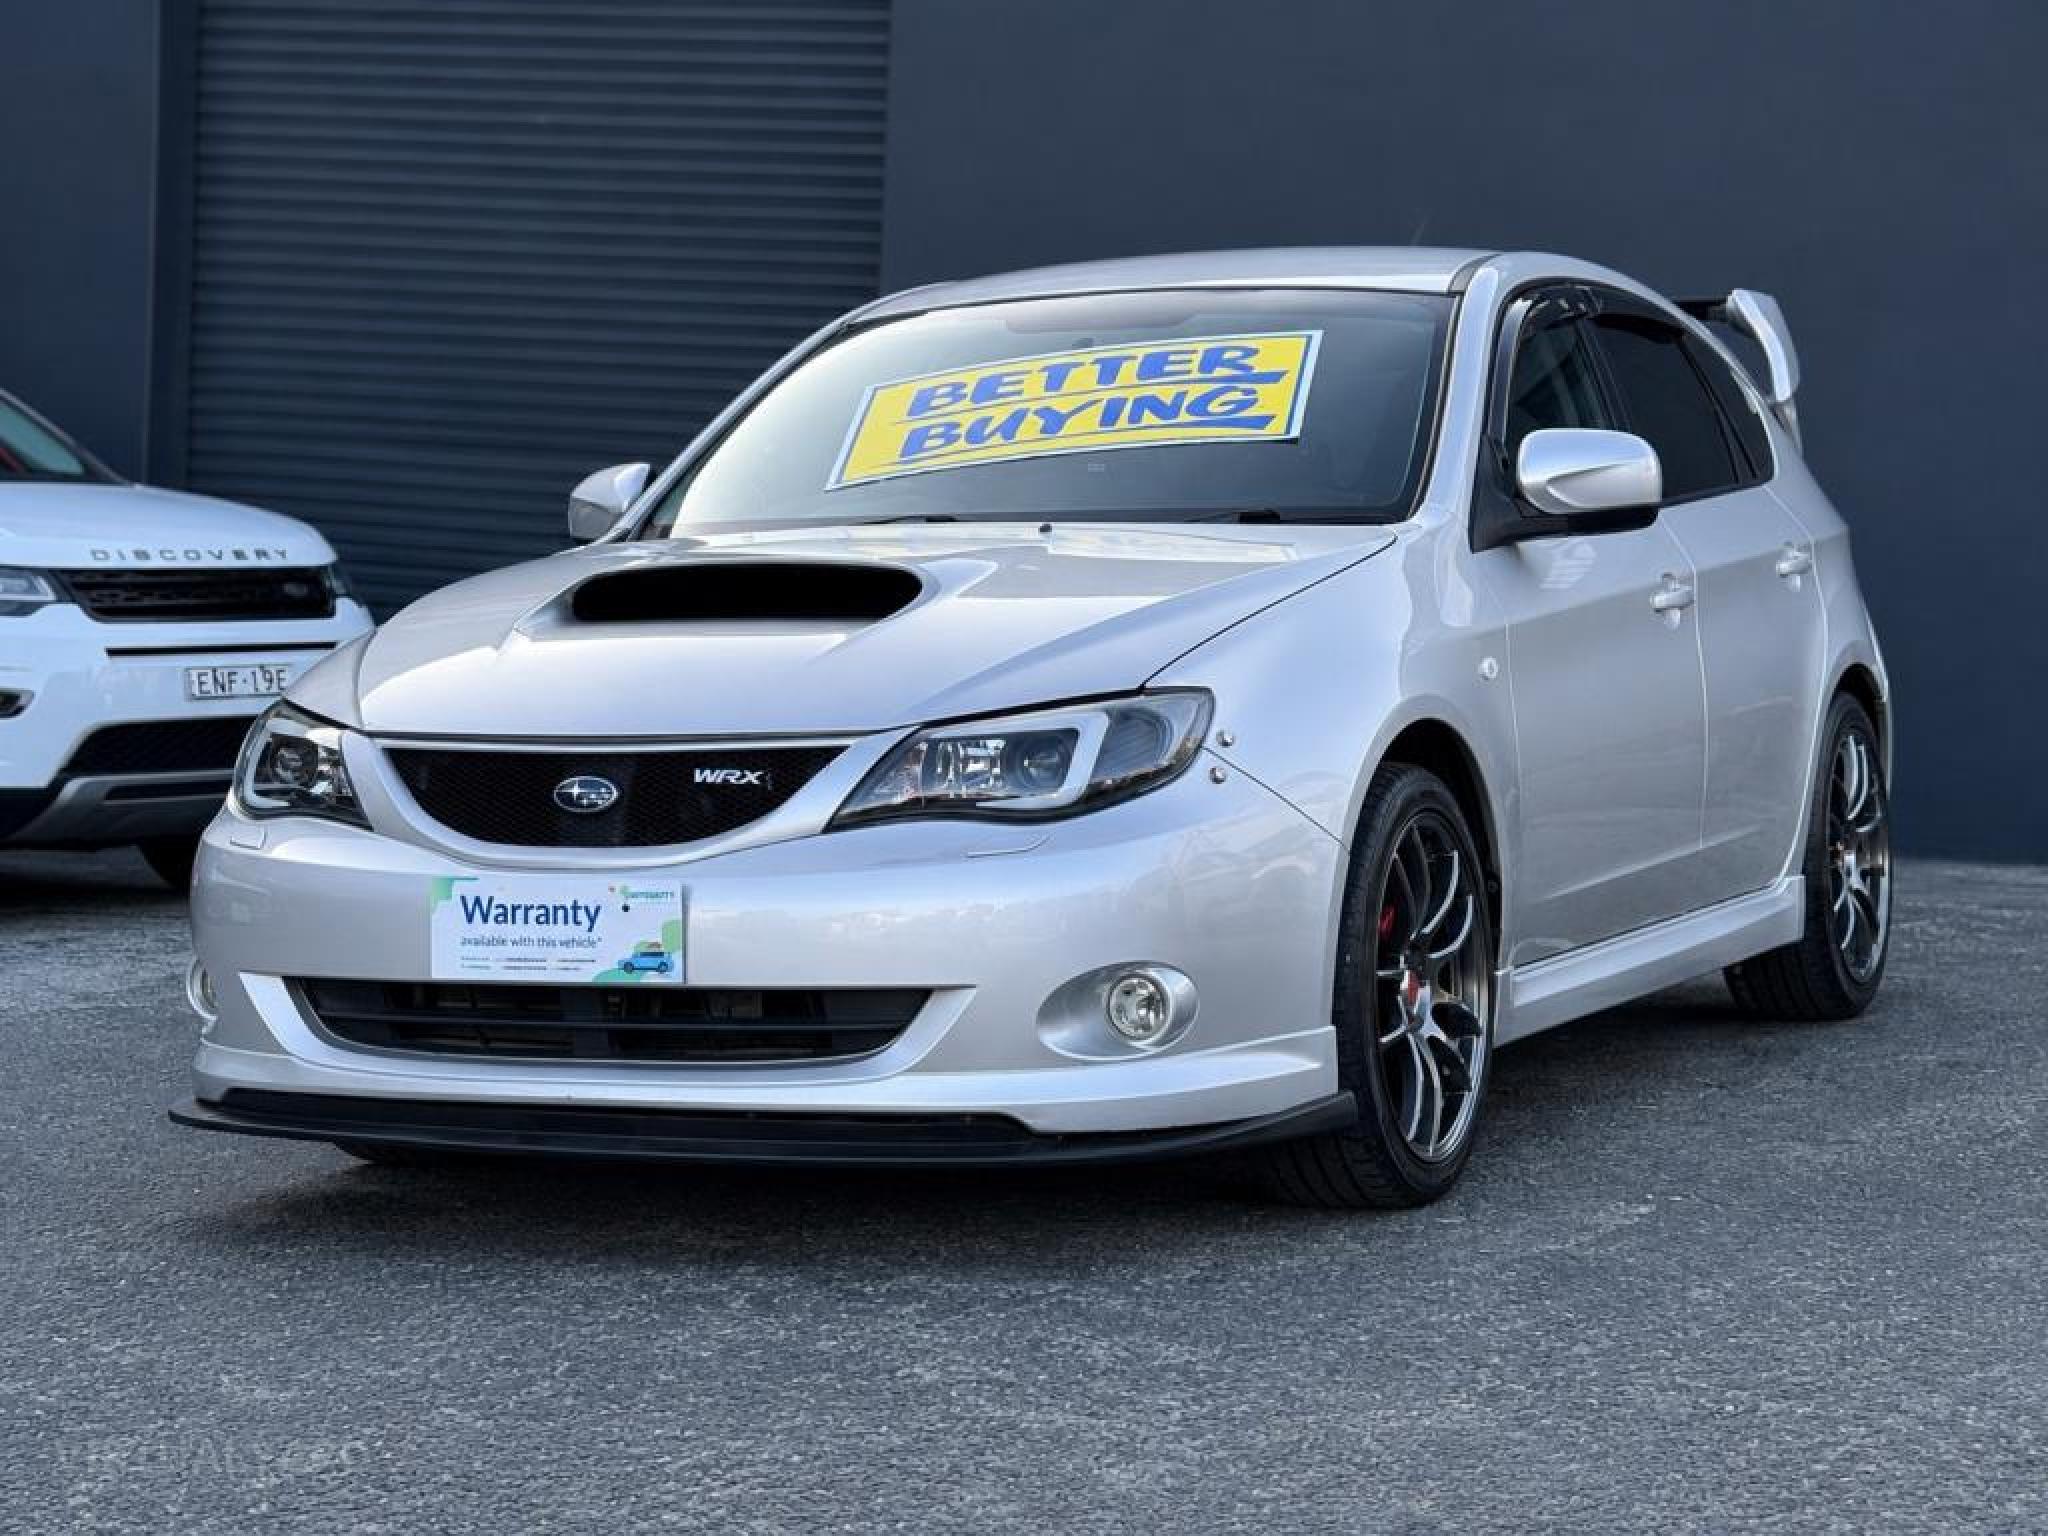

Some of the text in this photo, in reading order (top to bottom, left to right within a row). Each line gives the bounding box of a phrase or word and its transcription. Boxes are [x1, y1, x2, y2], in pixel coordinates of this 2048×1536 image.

[905, 344, 1264, 417] BETTER
[900, 385, 1262, 458] BUYING
[90, 548, 287, 561] DISCOVERY
[694, 768, 763, 784] WRX
[460, 894, 602, 932] Warranty
[461, 936, 508, 947] available
[510, 936, 535, 948] with
[537, 936, 557, 948] this
